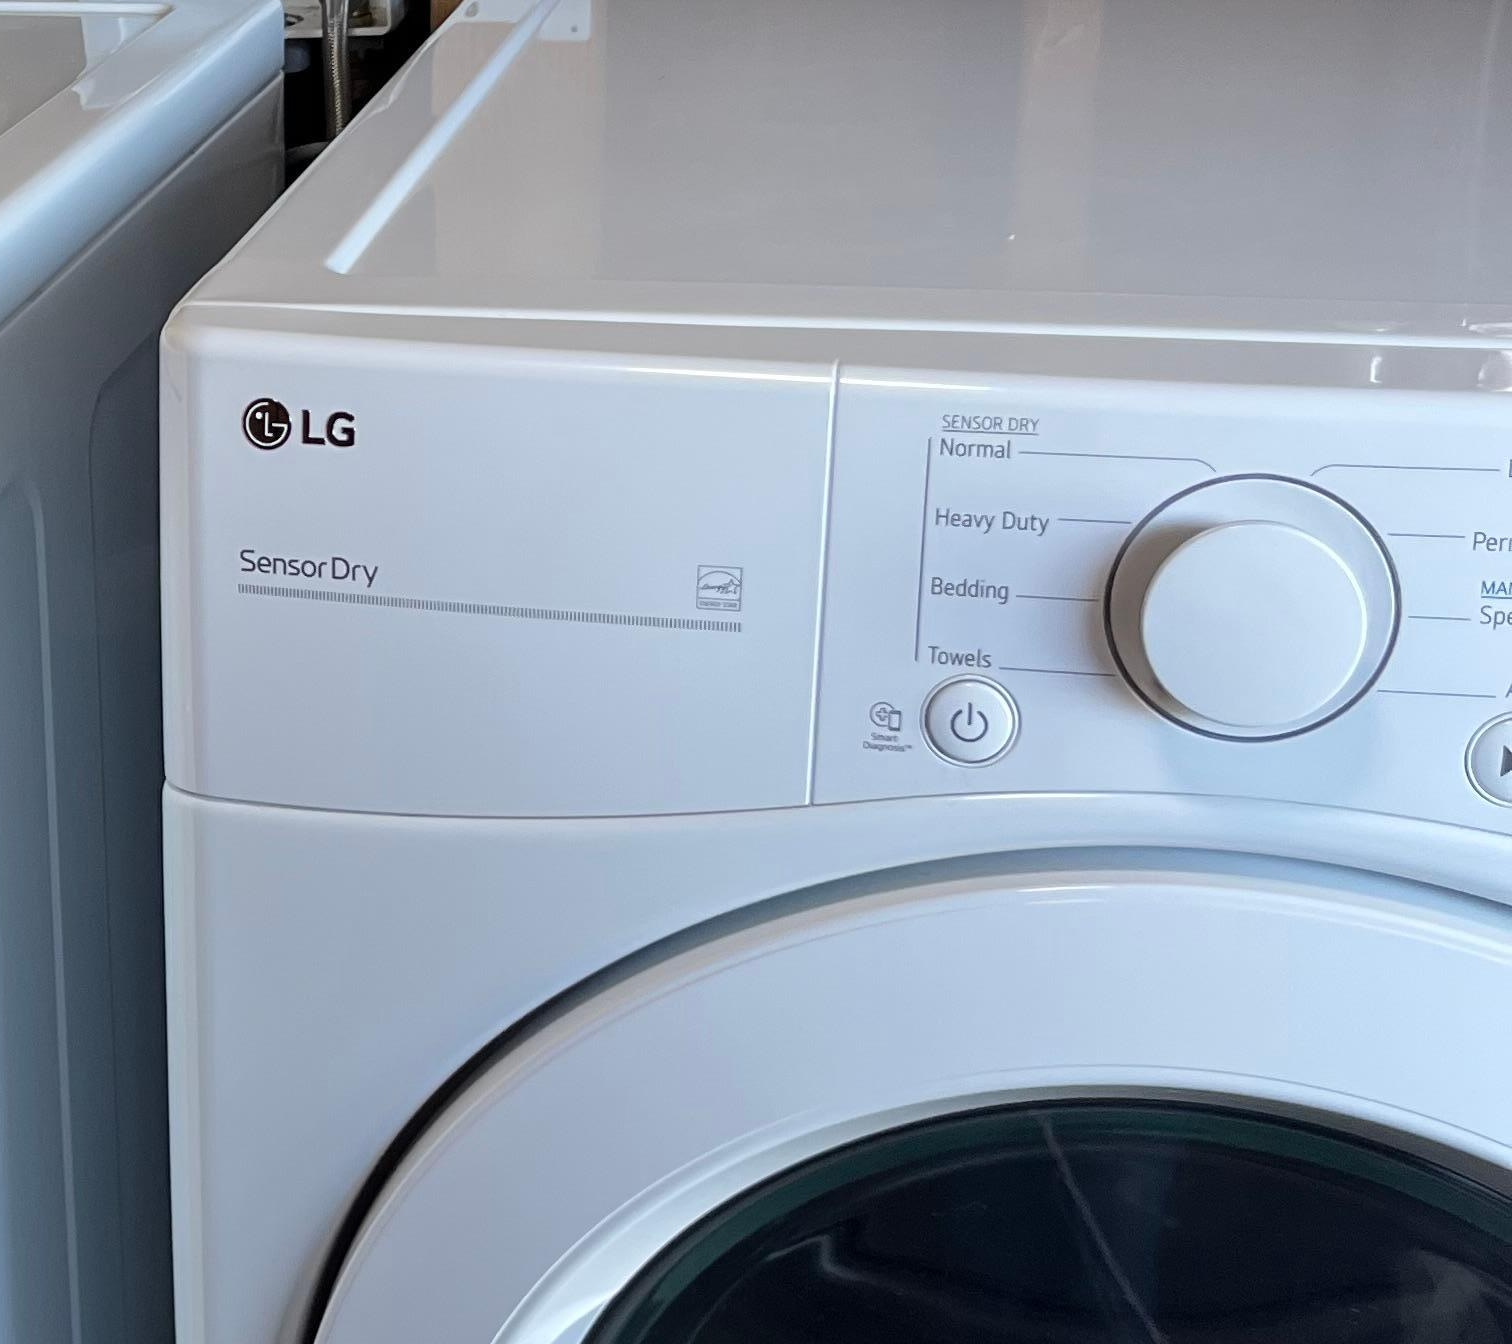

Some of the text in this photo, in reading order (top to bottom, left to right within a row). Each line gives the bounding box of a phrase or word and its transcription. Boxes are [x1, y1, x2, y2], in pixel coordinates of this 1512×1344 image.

[301, 409, 356, 448] LG
[942, 414, 1040, 432] SENSOR DRY
[939, 437, 1012, 460] Normal
[935, 507, 1050, 537] Heavy Duty
[930, 576, 1009, 605] Bedding
[927, 645, 993, 669] Towels
